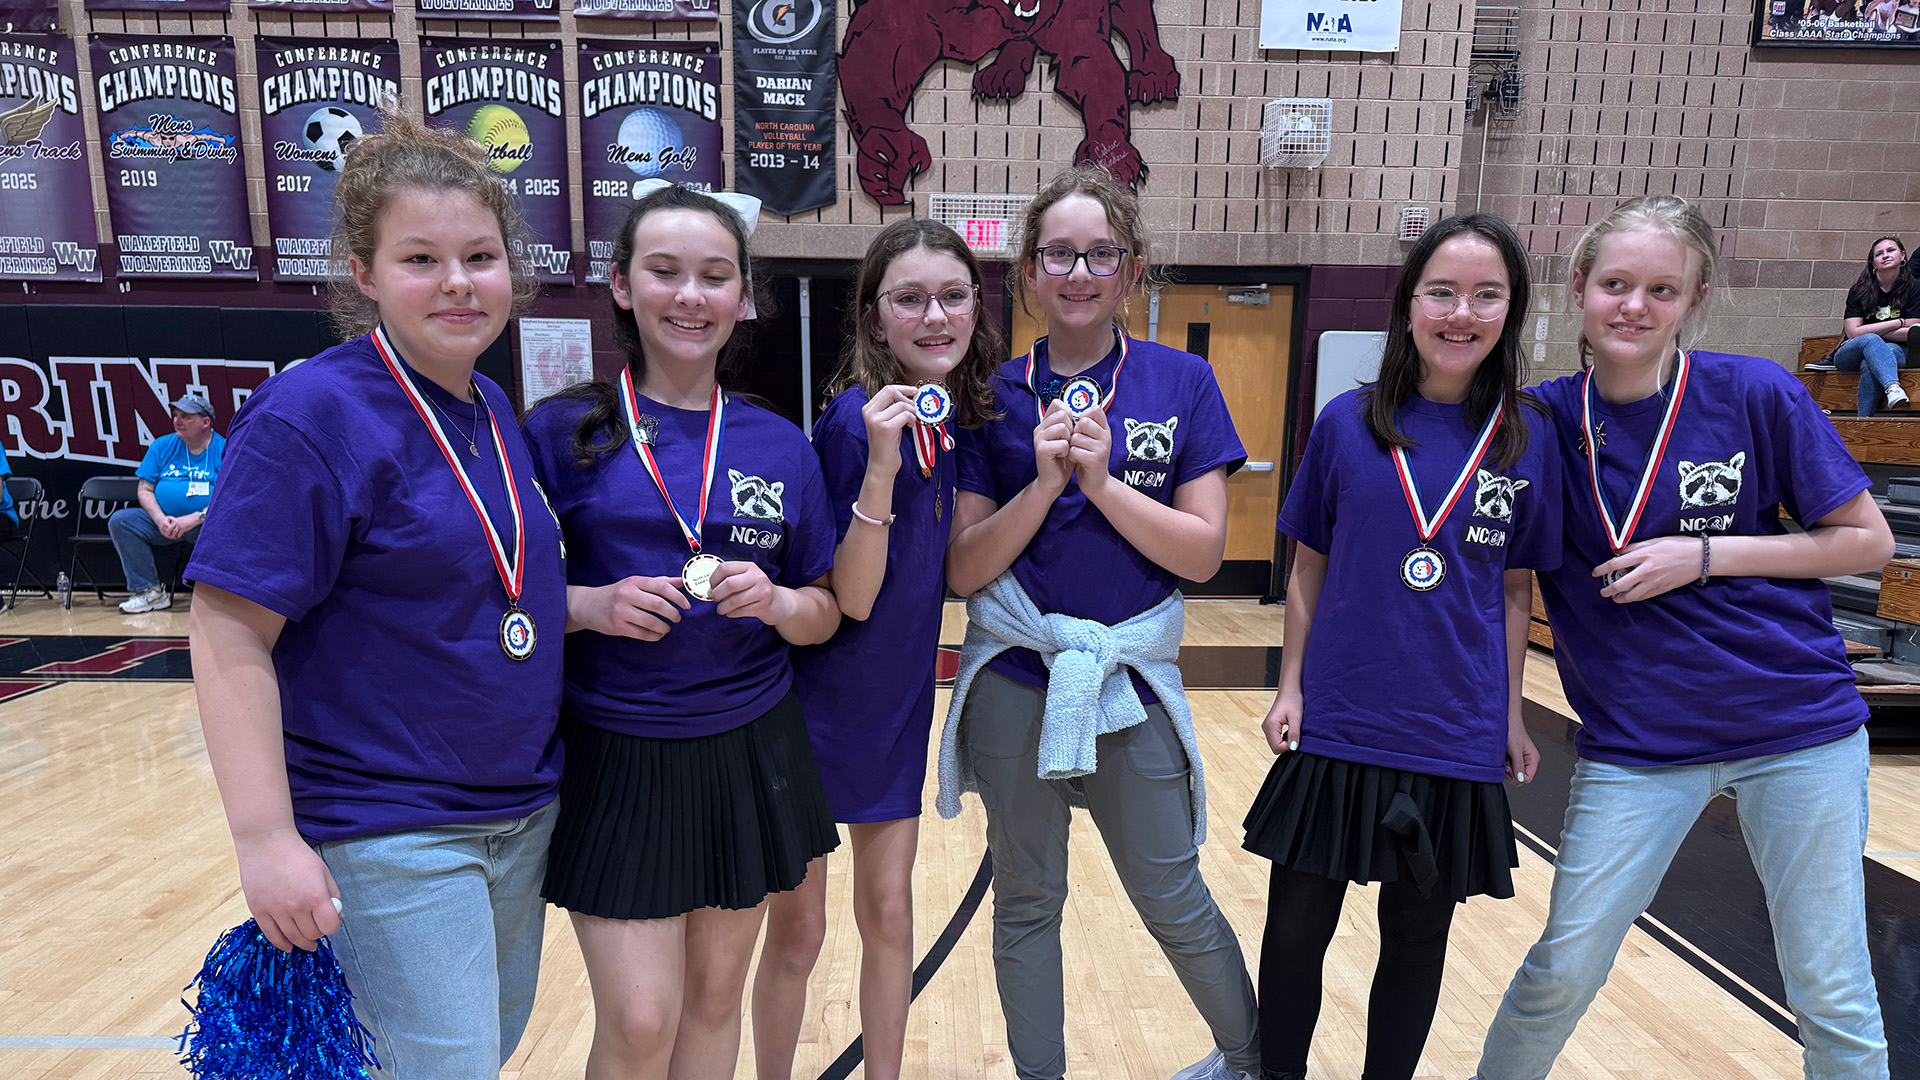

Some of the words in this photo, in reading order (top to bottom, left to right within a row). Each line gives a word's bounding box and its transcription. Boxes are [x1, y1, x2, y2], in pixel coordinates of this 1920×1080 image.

[1827, 20, 1875, 28] Basketball
[1311, 36, 1347, 44] www.nata.org
[1769, 29, 1795, 38] Class
[1796, 30, 1822, 38] AAAA
[1825, 30, 1851, 39] State
[1852, 30, 1901, 41] Champions
[109, 43, 218, 67] CONFERENCE
[275, 47, 382, 70] CONFERENCE
[436, 46, 548, 70] CONFERENCE
[592, 50, 705, 74] CONFERENCE
[0, 62, 78, 115] PIONS
[99, 64, 237, 115] CHAMPIONS
[263, 67, 398, 115] CHAMPIONS
[426, 66, 562, 118] CHAMPIONS
[756, 76, 812, 91] DARIAN
[583, 70, 717, 121] CHAMPIONS
[763, 92, 806, 106] MACK
[148, 113, 195, 133] Mens
[755, 122, 779, 130] NORTH
[780, 123, 815, 132] CAROLINA
[748, 141, 775, 150] PLAYER
[776, 142, 786, 150] OF
[787, 142, 801, 151] THE
[803, 143, 822, 151] YEAR
[763, 132, 807, 141] VOLLEYBALL
[25, 139, 82, 160] Track
[110, 141, 178, 164] Swimming
[180, 141, 193, 158] &
[195, 142, 237, 164] Diving
[274, 141, 339, 161] Womens
[484, 141, 533, 166] ftball
[607, 143, 653, 164] Mens
[657, 146, 697, 171] Golf
[750, 153, 785, 168] 2013
[803, 154, 820, 170] 14
[0, 172, 37, 189] 2025
[120, 170, 158, 187] 2019
[277, 174, 312, 192] 2017
[525, 178, 560, 196] 2025
[593, 180, 628, 197] 2022
[967, 219, 1000, 247] EXIT
[118, 235, 200, 253] WAKEFIELD
[275, 237, 333, 256] WAKEFI
[120, 255, 212, 273] WOLVERINES
[277, 258, 337, 276] WOLVE
[0, 356, 305, 468] RINE
